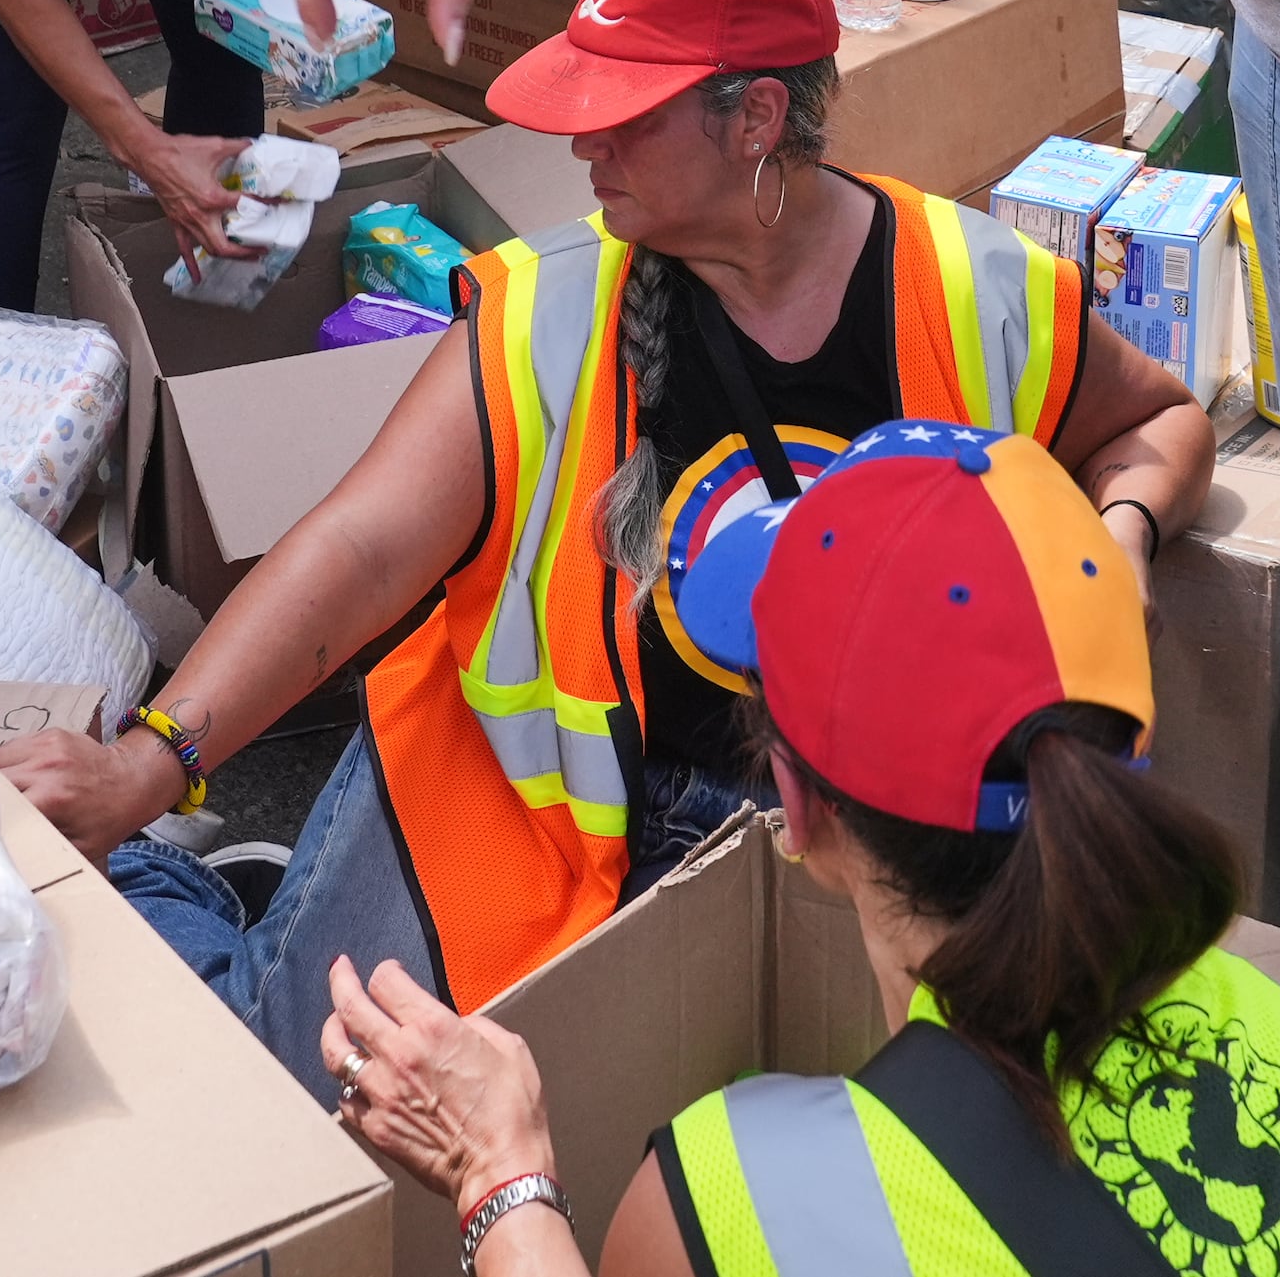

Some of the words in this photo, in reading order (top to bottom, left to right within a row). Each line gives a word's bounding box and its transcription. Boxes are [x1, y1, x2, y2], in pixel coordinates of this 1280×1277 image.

[1055, 148, 1110, 165] Gerber
[1011, 188, 1054, 203] VARIETY
[1055, 196, 1083, 208] PACK
